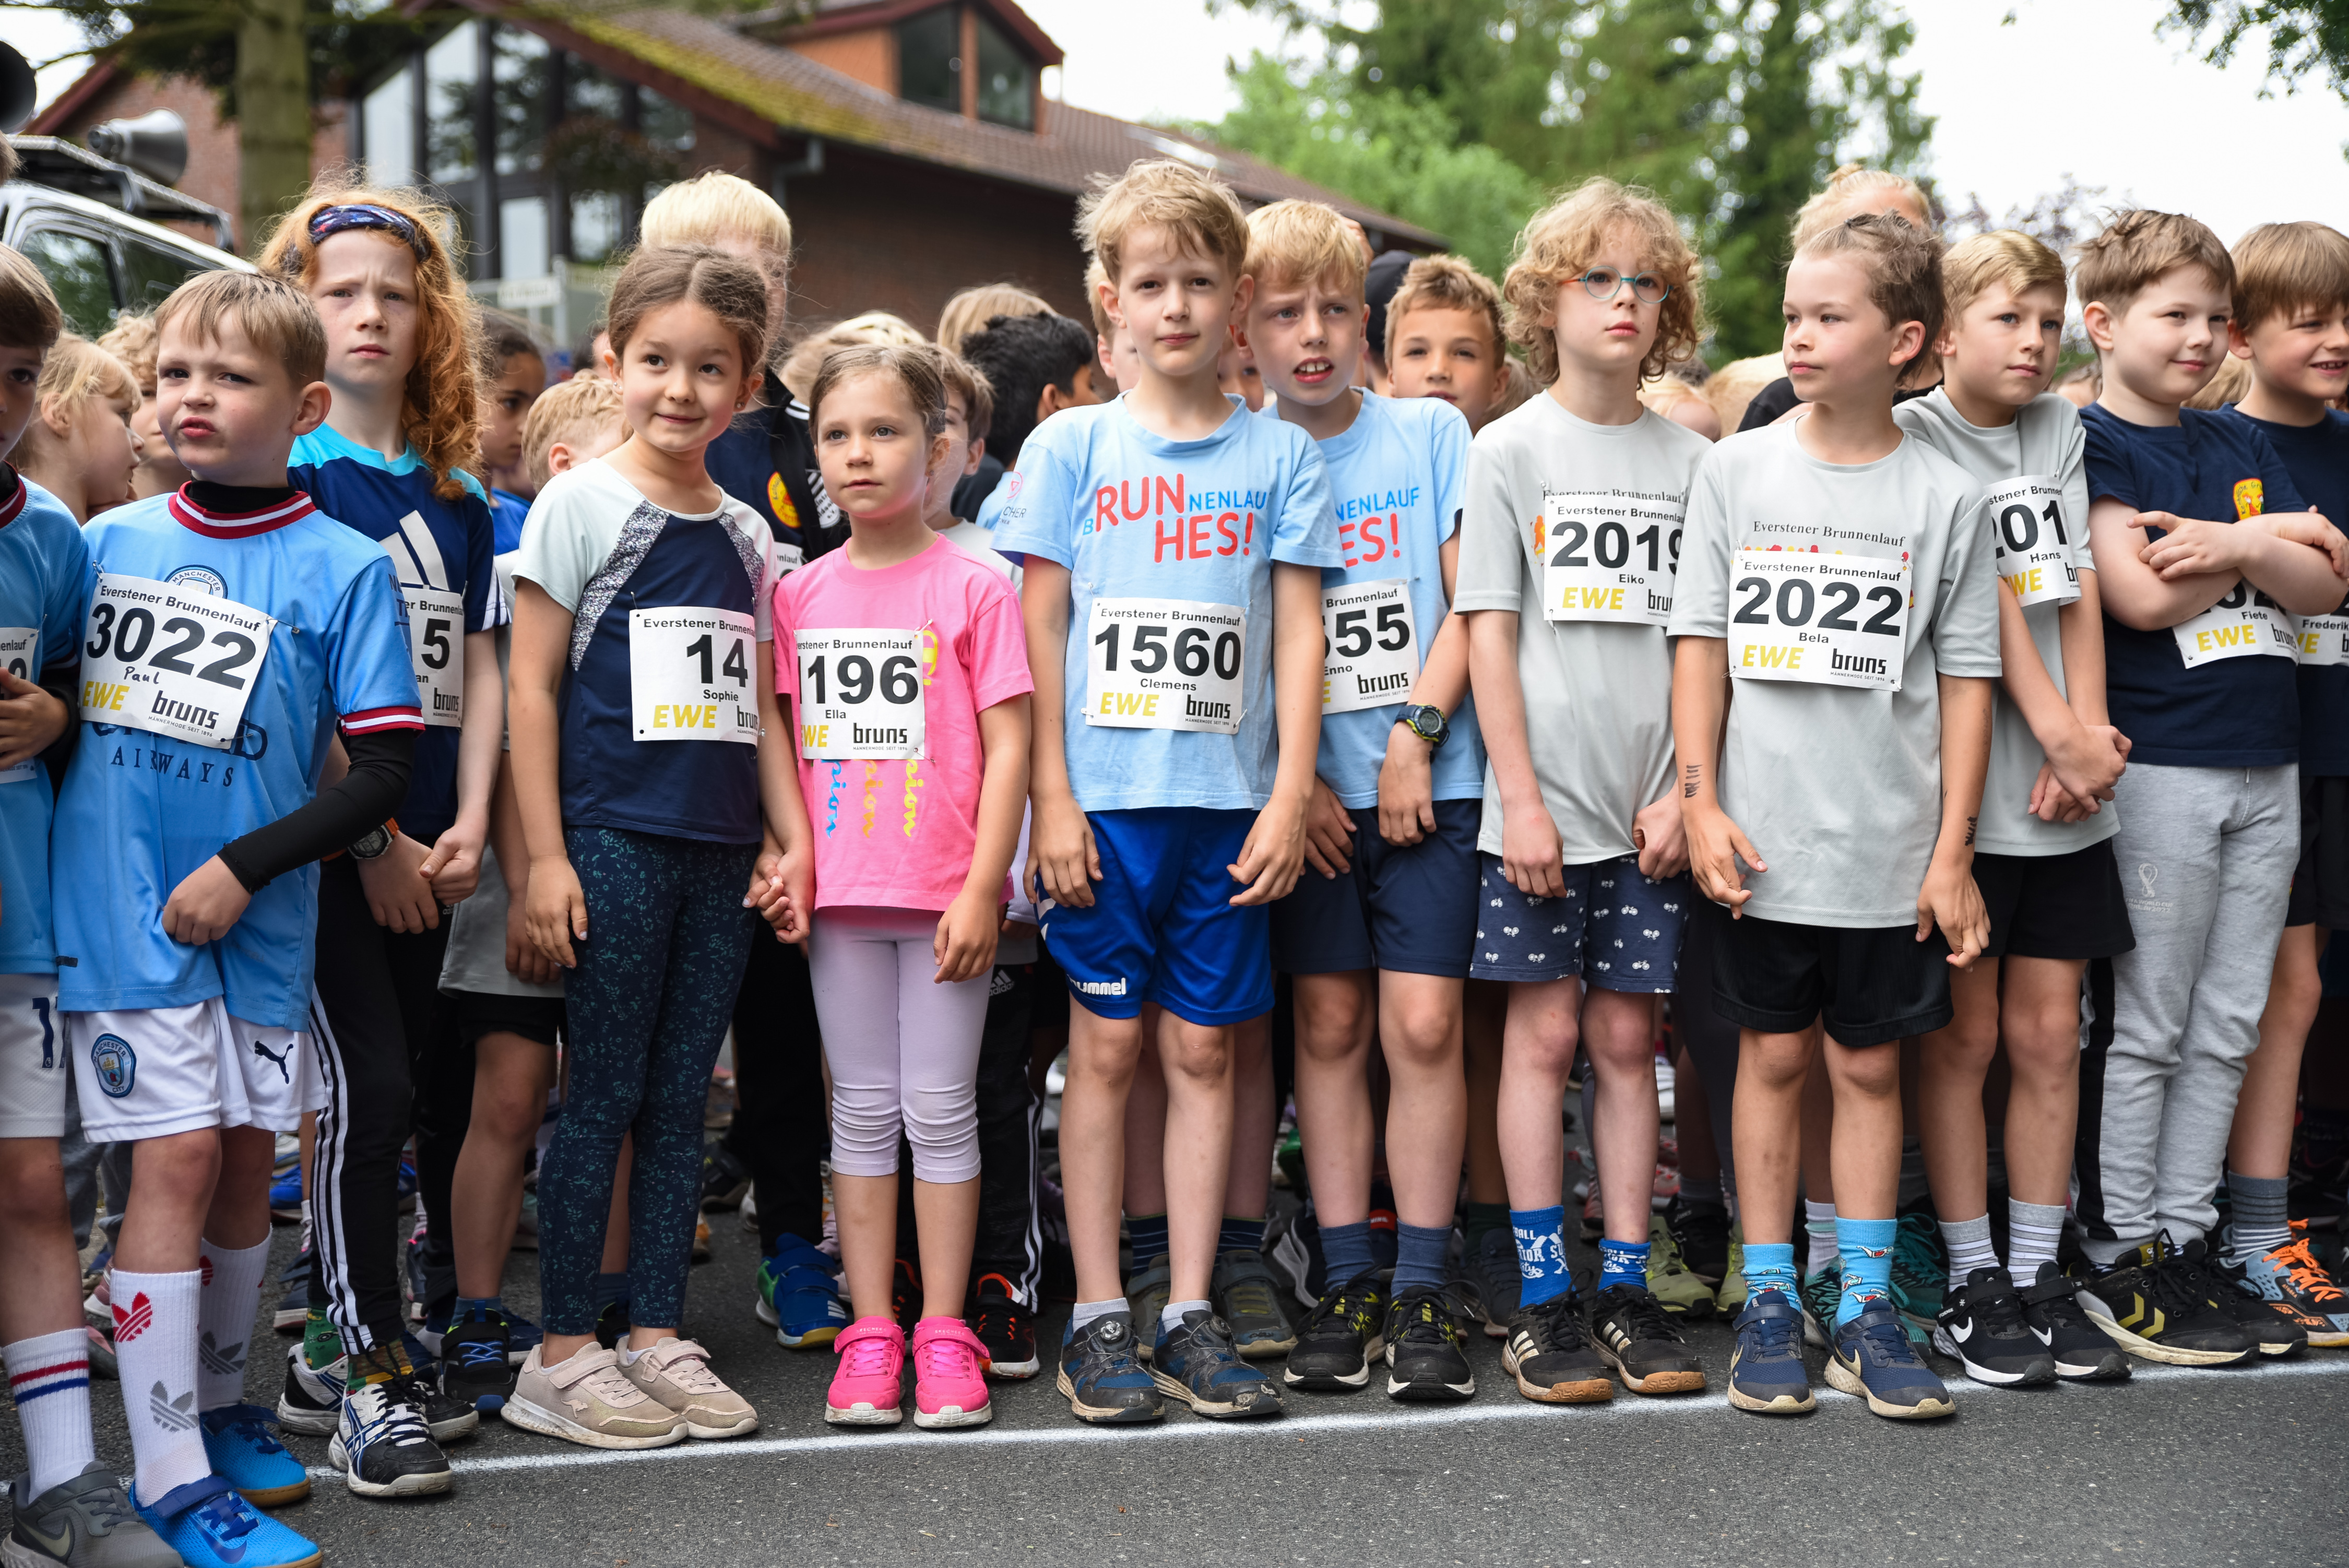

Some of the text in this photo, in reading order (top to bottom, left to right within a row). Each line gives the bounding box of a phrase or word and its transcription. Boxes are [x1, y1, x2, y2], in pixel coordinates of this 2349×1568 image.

[1558, 506, 1627, 516] Everstener
[1154, 511, 1254, 563] HES!
[1753, 521, 1906, 547] Everstener Brunnenlauf
[1550, 521, 1682, 575] 2019
[2030, 552, 2061, 563] Hans
[172, 571, 220, 591] MANCHESTER
[1619, 574, 1644, 584] Eiko
[1745, 561, 1901, 581] Everstener Brunnenlauf
[1326, 588, 1398, 608] Brunnenlauf
[1562, 587, 1625, 610] EWE
[1733, 577, 1903, 637] 2022
[100, 586, 260, 632] Everstener Brunnenlauf
[1101, 609, 1241, 626] Everstener Brunnenlauf
[2241, 611, 2268, 620] Fiete
[644, 619, 716, 628] Everstener
[2303, 619, 2349, 631] Frederik
[0, 639, 27, 651] enlauf
[86, 603, 257, 691] 3022
[833, 639, 912, 649] Brunnenlauf
[1799, 632, 1829, 643] Bela
[2197, 624, 2256, 652] EWE
[686, 634, 749, 688] 14
[1095, 624, 1241, 680] 1560
[1742, 645, 1887, 675] EWE bruns
[123, 666, 160, 684] Paul
[1140, 679, 1197, 691] Clemens
[1357, 672, 1409, 694] bruns
[82, 681, 219, 730] EWE bruns
[433, 687, 459, 712] bruns
[703, 690, 739, 702] Sophie
[1100, 692, 1231, 719] EWE bruns
[148, 716, 186, 730] MÄNNERMODE
[653, 705, 718, 728] EWE
[825, 709, 846, 719] Ella
[853, 722, 908, 744] bruns
[111, 745, 234, 787] AIRWAYS
[1067, 974, 1126, 995] hummel
[93, 1041, 126, 1063] MANCHESTER
